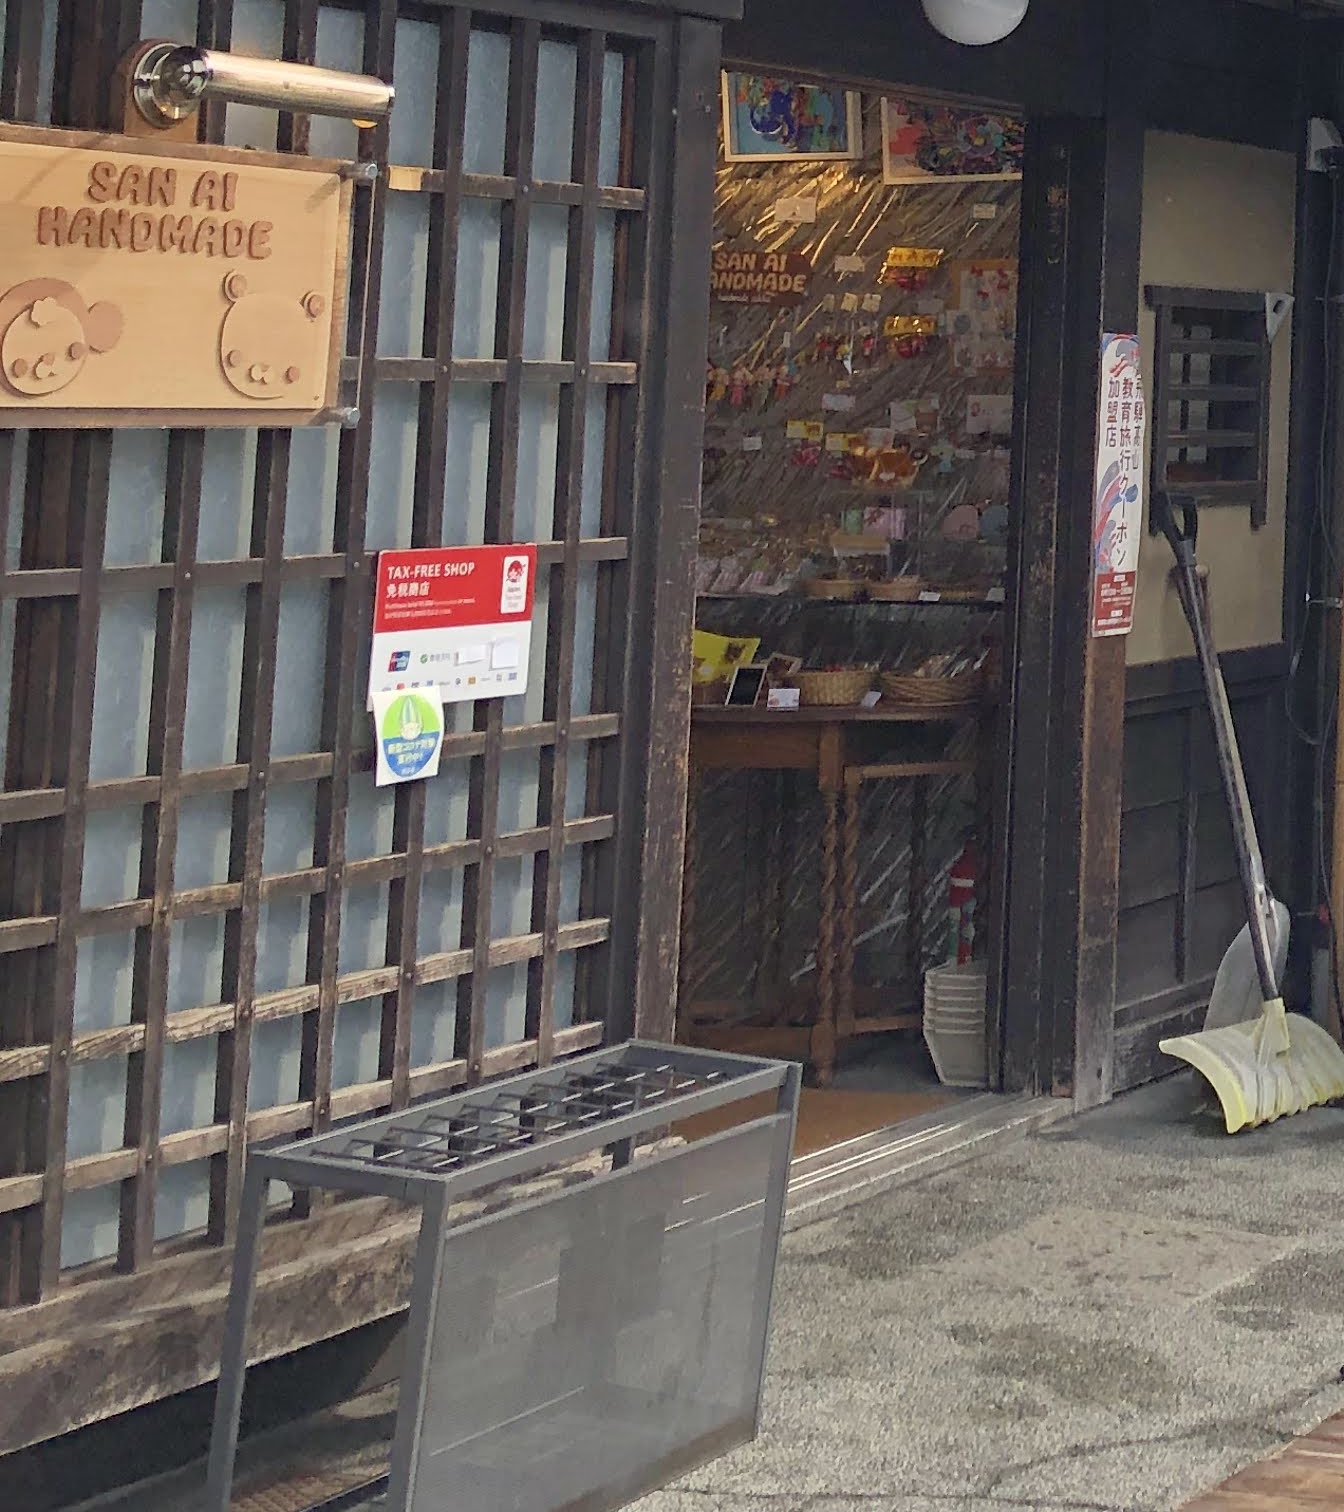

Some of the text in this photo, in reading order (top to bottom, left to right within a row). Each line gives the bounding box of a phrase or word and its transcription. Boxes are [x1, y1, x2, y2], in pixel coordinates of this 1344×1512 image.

[88, 161, 239, 212] SAN AI
[37, 206, 274, 260] HANDMADE
[710, 272, 807, 293] ANDMADE
[714, 251, 788, 272] SAN AI
[1105, 378, 1119, 449] 加盟店
[1115, 377, 1134, 567] 教育旅行クーポン
[387, 561, 475, 580] TAX-FREE SHOP
